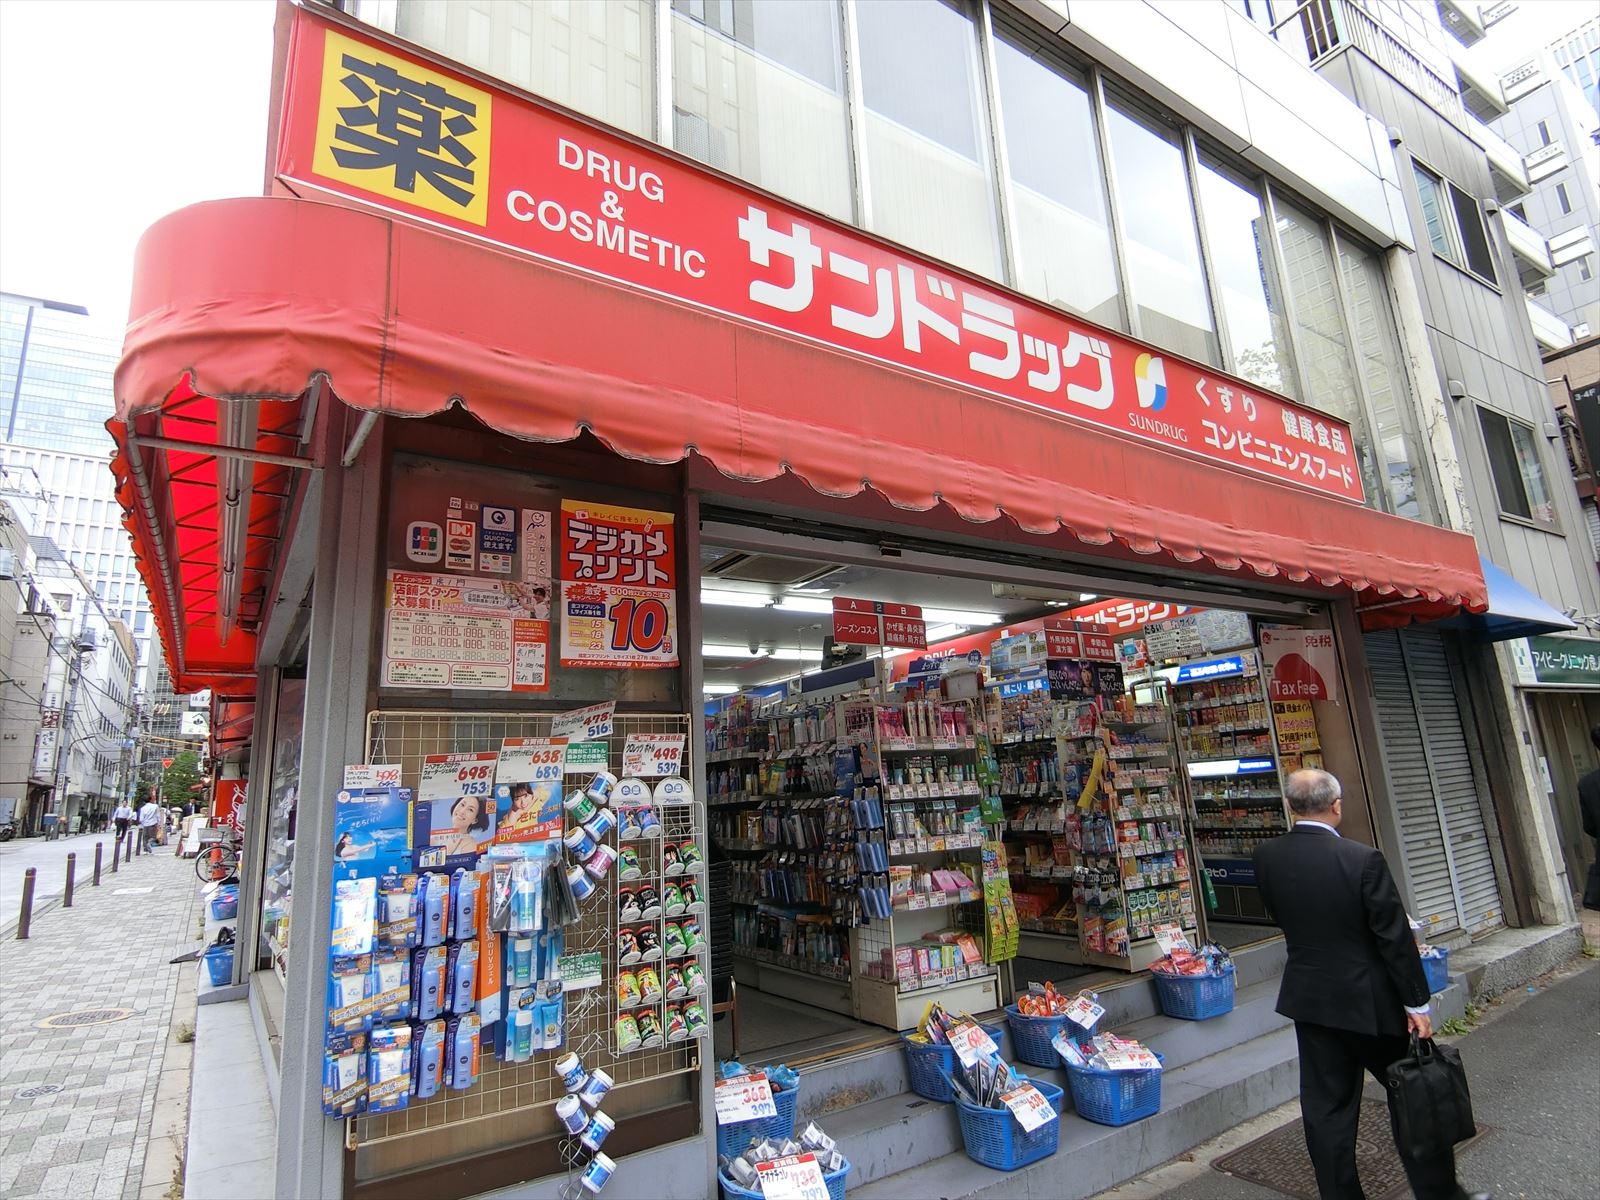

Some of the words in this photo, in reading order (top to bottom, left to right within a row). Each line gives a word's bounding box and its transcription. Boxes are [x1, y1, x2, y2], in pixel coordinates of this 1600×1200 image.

[329, 52, 478, 208] 薬
[558, 137, 664, 204] DRUG
[600, 189, 624, 222] &
[506, 189, 706, 279] COSMETIC
[738, 206, 1116, 411] サンドラッグ
[1574, 388, 1596, 401] 3-4F
[1196, 379, 1259, 422] くすり
[1281, 411, 1347, 455] 健康食品
[1128, 411, 1188, 443] SUNDRUG
[1202, 419, 1353, 489] コンビニエンスフード
[413, 535, 438, 543] JCB
[484, 535, 513, 543] QUICPay
[568, 519, 669, 557] デジカメ
[568, 552, 670, 585] プリント
[393, 584, 461, 599] 店舗スタッフ
[850, 601, 857, 609] A
[876, 604, 882, 612] 2
[901, 607, 907, 615] B
[609, 598, 669, 653] 10
[836, 623, 878, 635] シーズンコスメ
[1305, 635, 1332, 648] 免税
[1272, 680, 1295, 696] Tax
[583, 711, 610, 726] 478
[587, 723, 609, 737] 516
[446, 754, 478, 762] お買得品
[532, 749, 561, 764] 638
[653, 747, 679, 760] 498
[458, 765, 490, 781] 698
[536, 765, 559, 779] 689
[657, 762, 677, 774] 537
[462, 781, 487, 795] 753
[742, 1086, 767, 1104] 368
[751, 1102, 771, 1116] 397
[790, 1168, 818, 1188] 738
